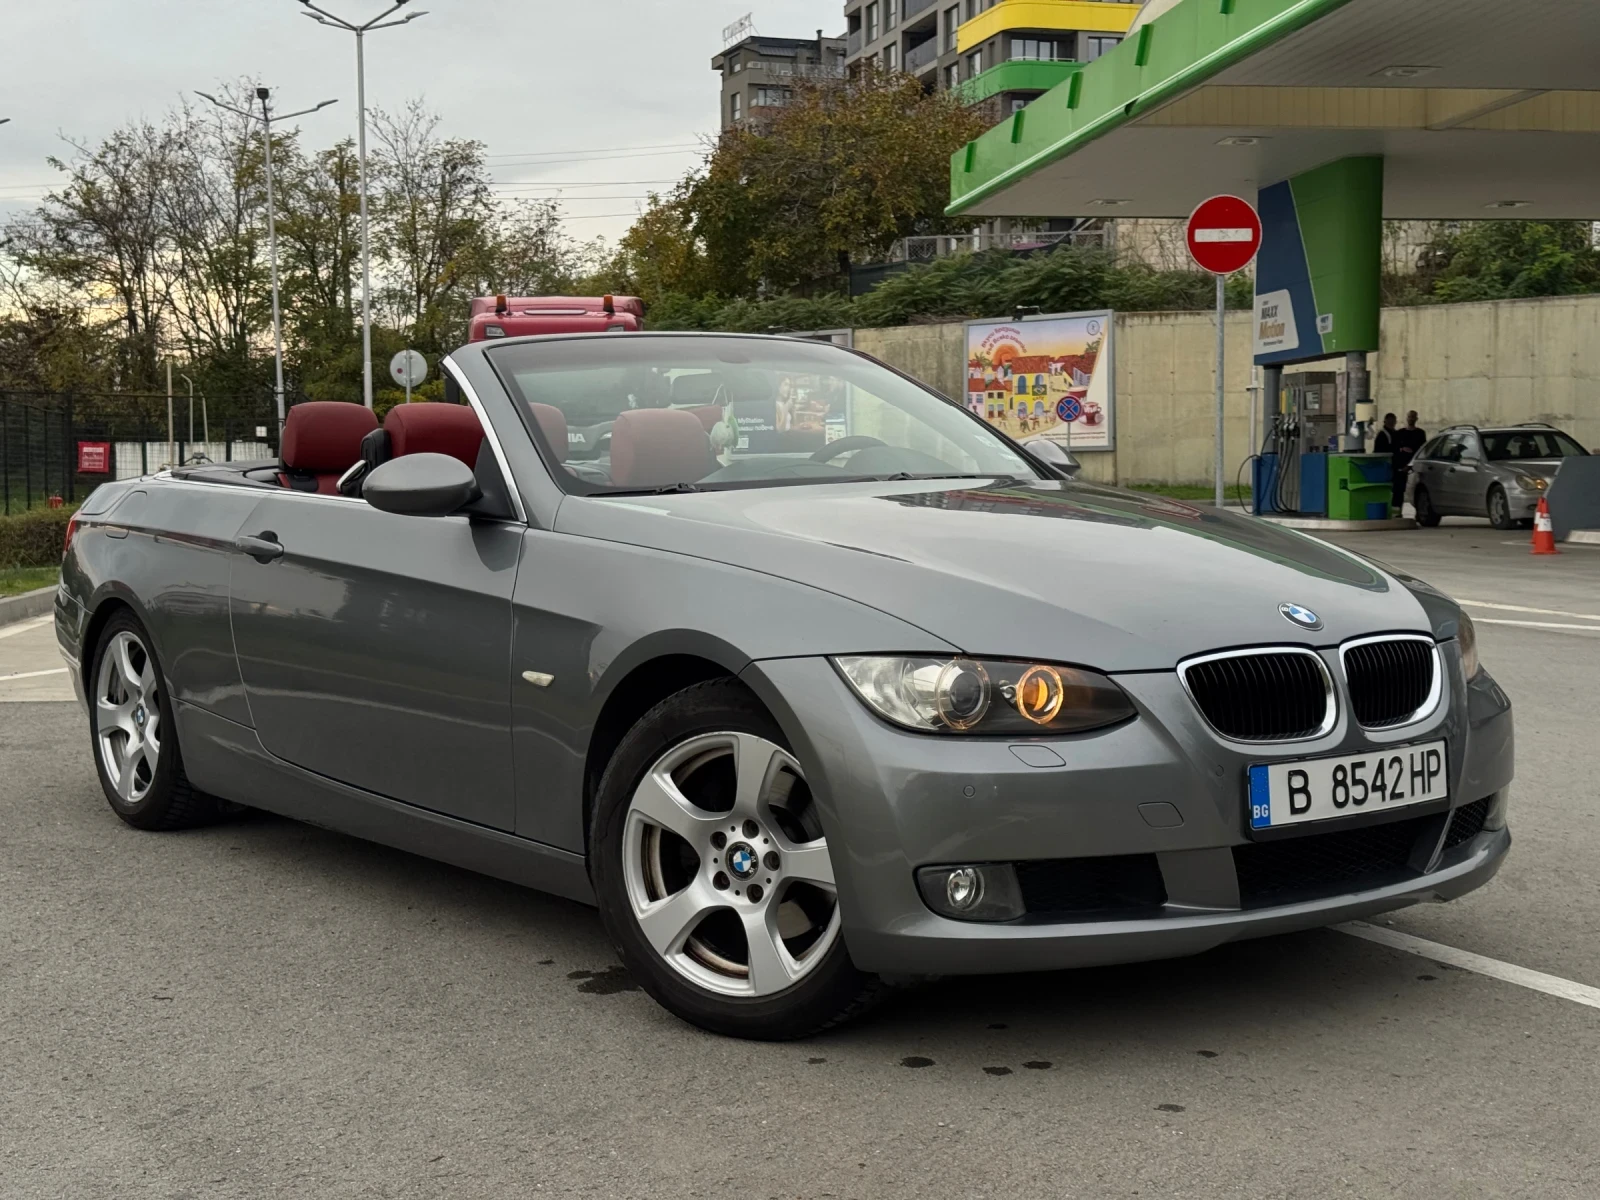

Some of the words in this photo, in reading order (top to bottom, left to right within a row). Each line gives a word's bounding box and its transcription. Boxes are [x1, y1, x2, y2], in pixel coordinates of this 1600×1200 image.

[1261, 305, 1278, 320] MAXX
[1259, 322, 1285, 340] Motion
[1288, 769, 1312, 815] B
[1332, 755, 1405, 809] 8542
[1410, 748, 1441, 797] HP
[1253, 804, 1269, 819] BG
